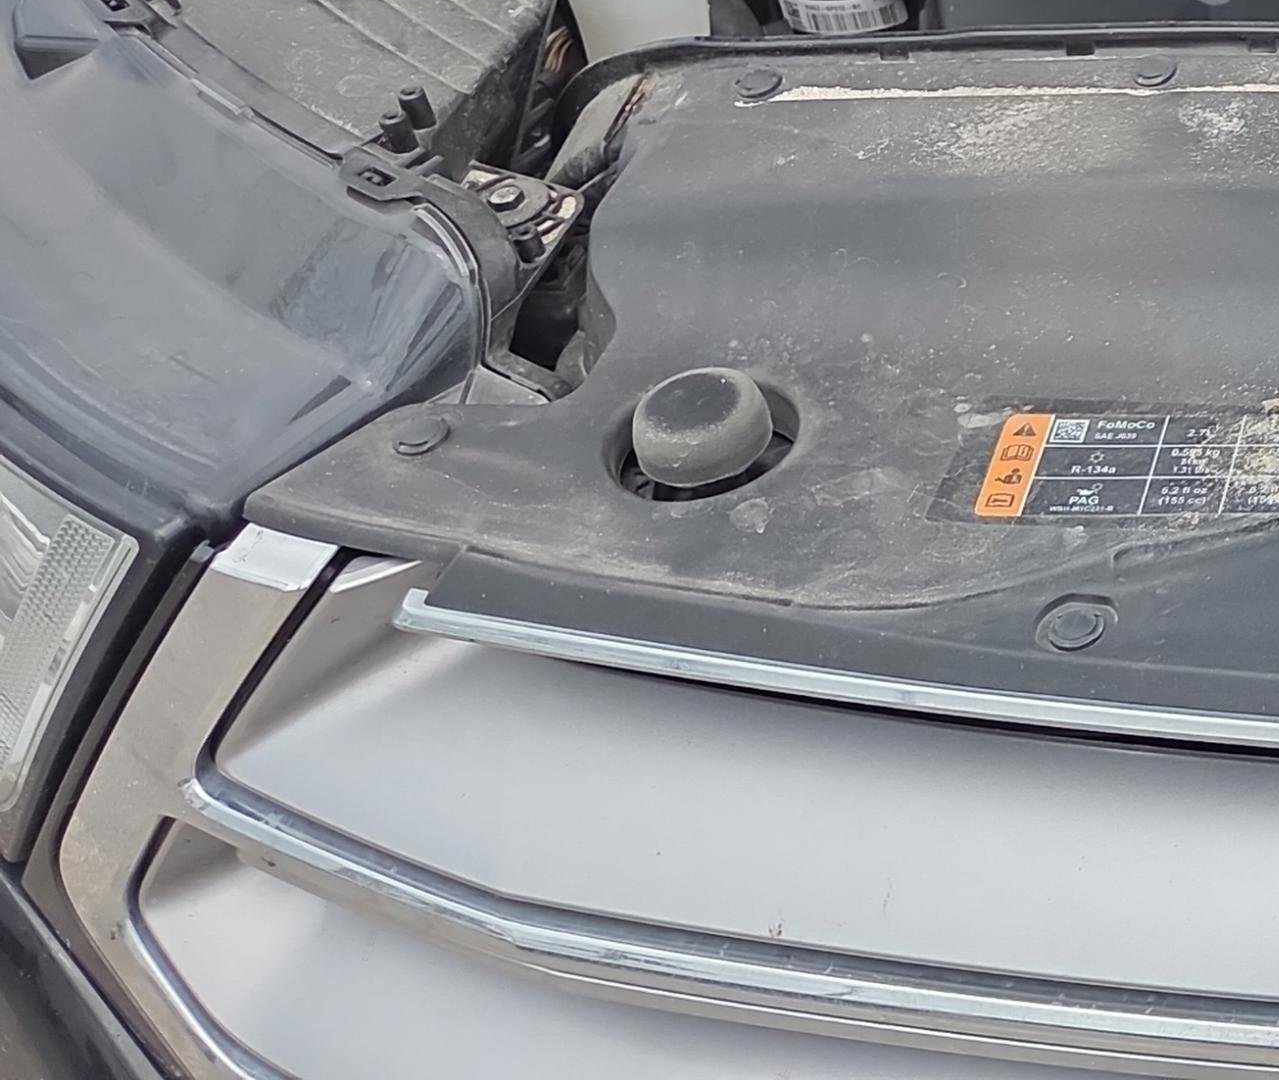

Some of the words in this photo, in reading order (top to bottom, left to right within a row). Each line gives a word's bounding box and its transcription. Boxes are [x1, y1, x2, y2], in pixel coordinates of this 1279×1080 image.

[1096, 419, 1156, 430] FoMoCo
[1071, 465, 1117, 474] R-134a
[1069, 496, 1100, 505] PAG
